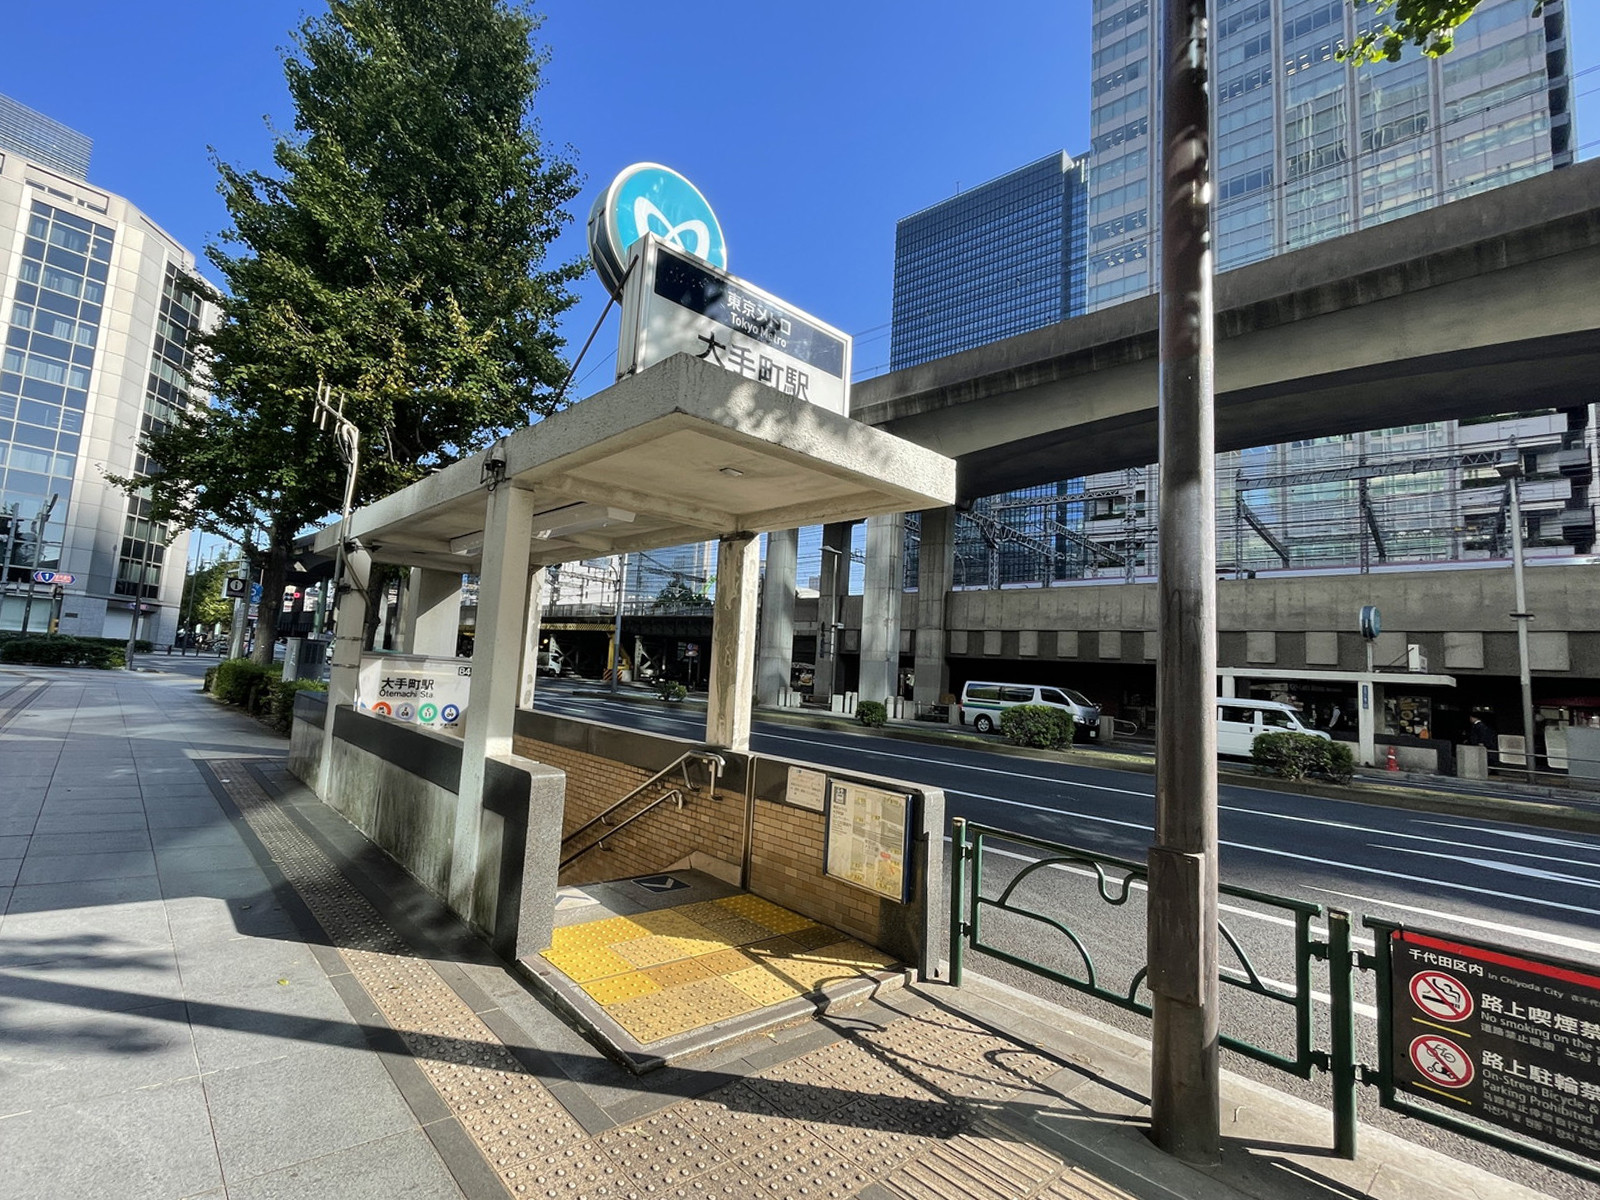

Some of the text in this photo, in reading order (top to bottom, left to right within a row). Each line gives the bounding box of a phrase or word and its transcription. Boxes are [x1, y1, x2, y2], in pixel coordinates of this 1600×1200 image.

[727, 291, 792, 336] 東京メトロ
[730, 311, 788, 348] Tokyo Metro
[696, 332, 810, 402] 大手町駅
[381, 677, 434, 690] 大手町駅
[1408, 948, 1484, 977] 千代田区内
[1500, 976, 1541, 992] Chiyoda
[1543, 987, 1564, 999] City
[1481, 1011, 1497, 1023] No
[1500, 1018, 1550, 1040] smoking
[1553, 1034, 1569, 1044] on
[1572, 1038, 1593, 1051] the
[1482, 1068, 1599, 1115] On-Street Bicycle &
[1482, 1078, 1594, 1124] Parking Prohibited
